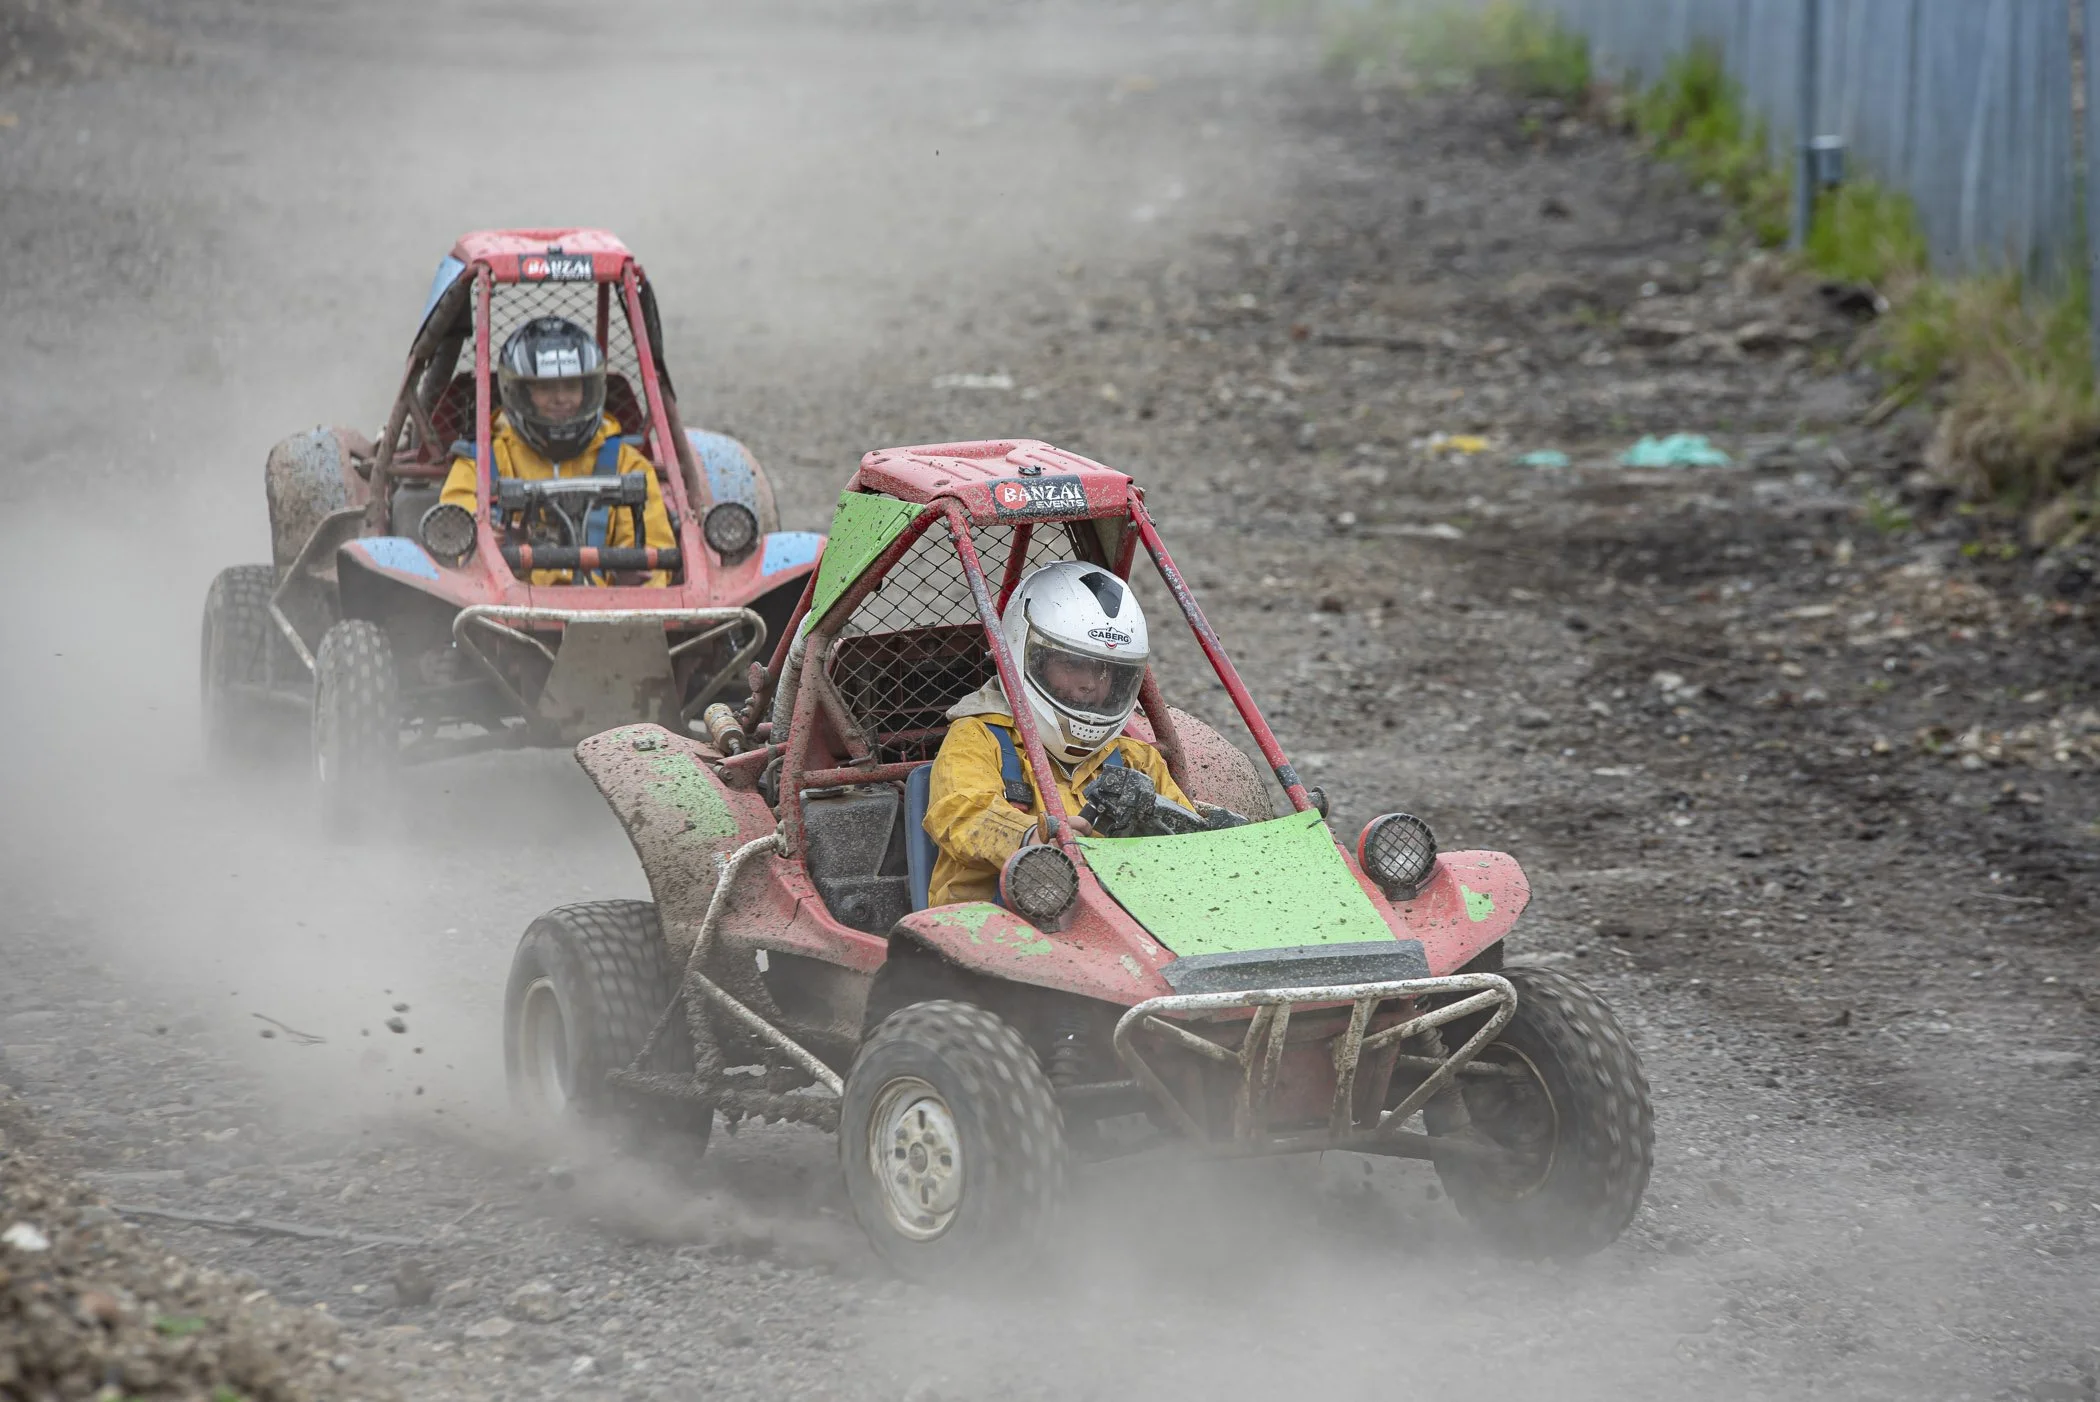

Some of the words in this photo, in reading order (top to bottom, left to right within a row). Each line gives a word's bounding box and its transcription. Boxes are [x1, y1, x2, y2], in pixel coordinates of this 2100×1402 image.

[527, 260, 591, 275] BANZAI
[1004, 485, 1082, 502] BANZAI
[1036, 499, 1085, 508] EVENTS
[1090, 630, 1129, 642] CABERG
